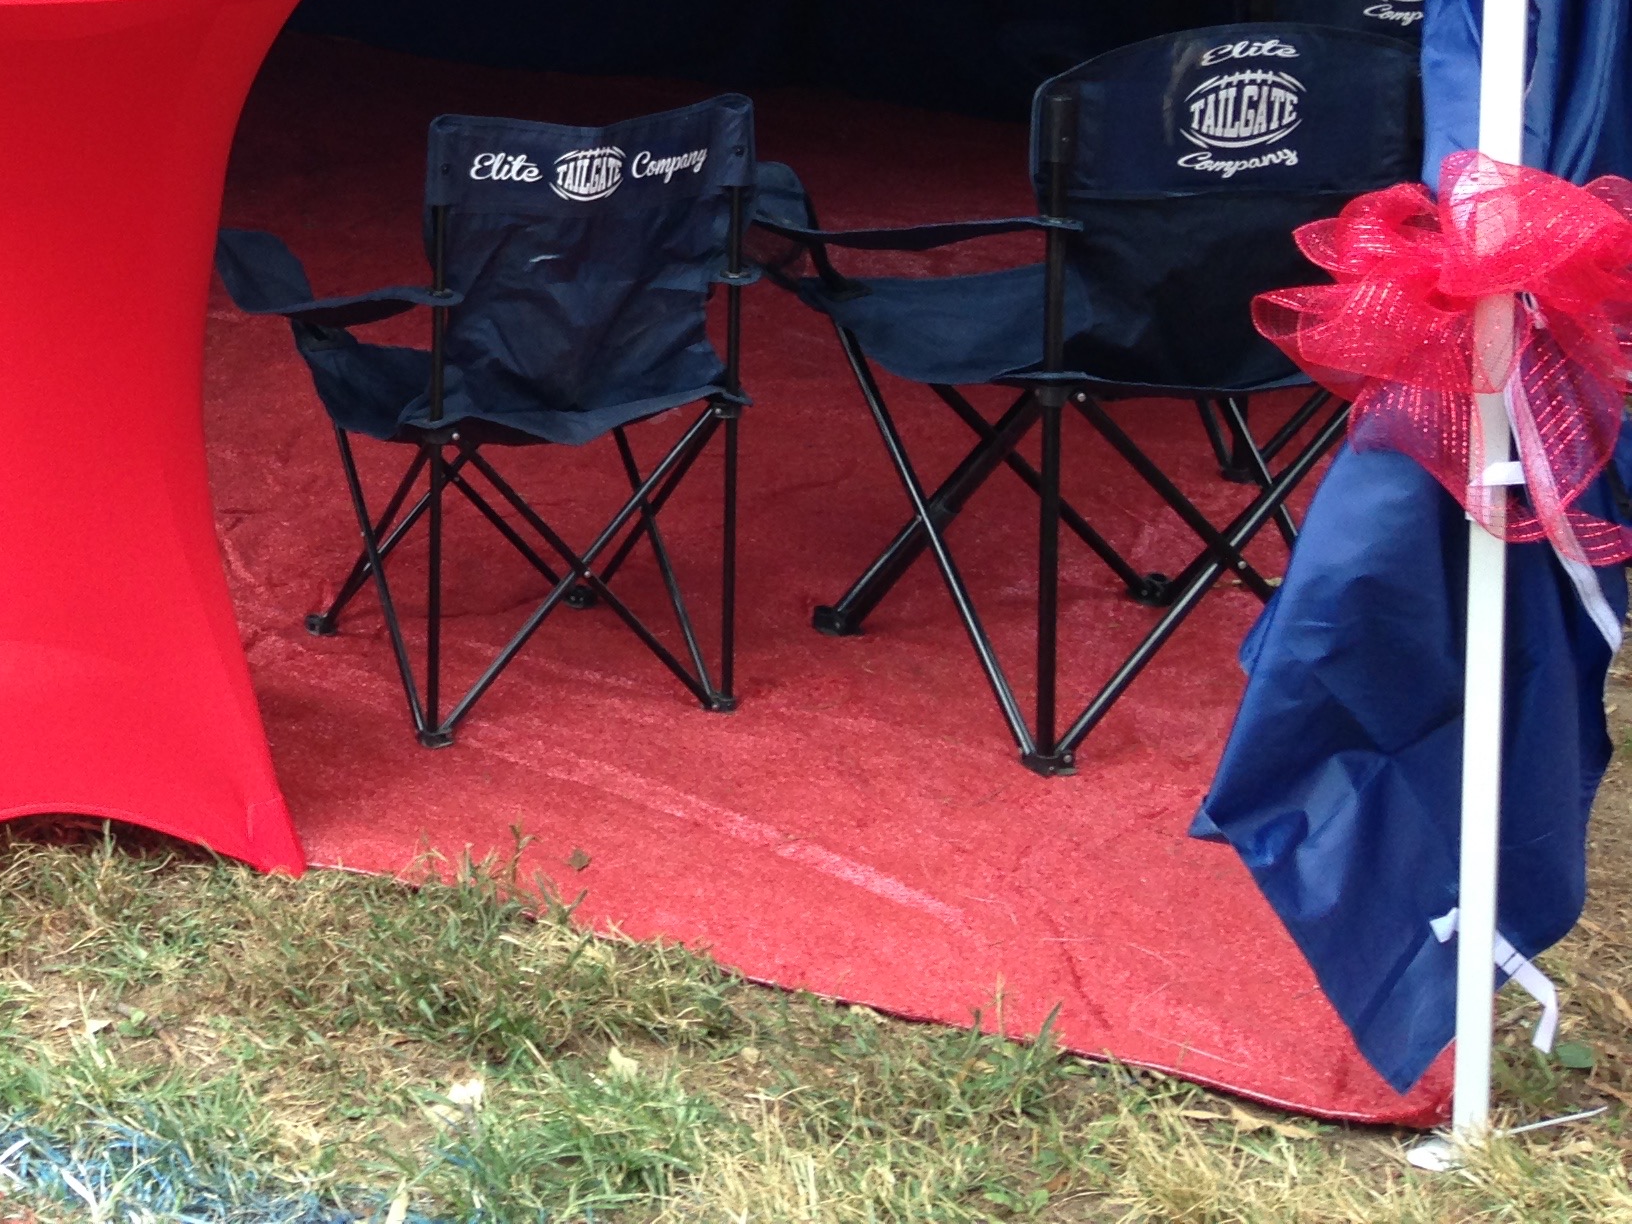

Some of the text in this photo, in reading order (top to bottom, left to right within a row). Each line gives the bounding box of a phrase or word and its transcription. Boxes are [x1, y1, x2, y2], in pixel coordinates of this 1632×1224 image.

[1362, 3, 1425, 26] Comp
[1200, 39, 1301, 67] Elite
[1189, 84, 1299, 138] TAILGATE
[469, 147, 708, 195] Elite TAILGATE Company
[1177, 148, 1299, 178] Company
